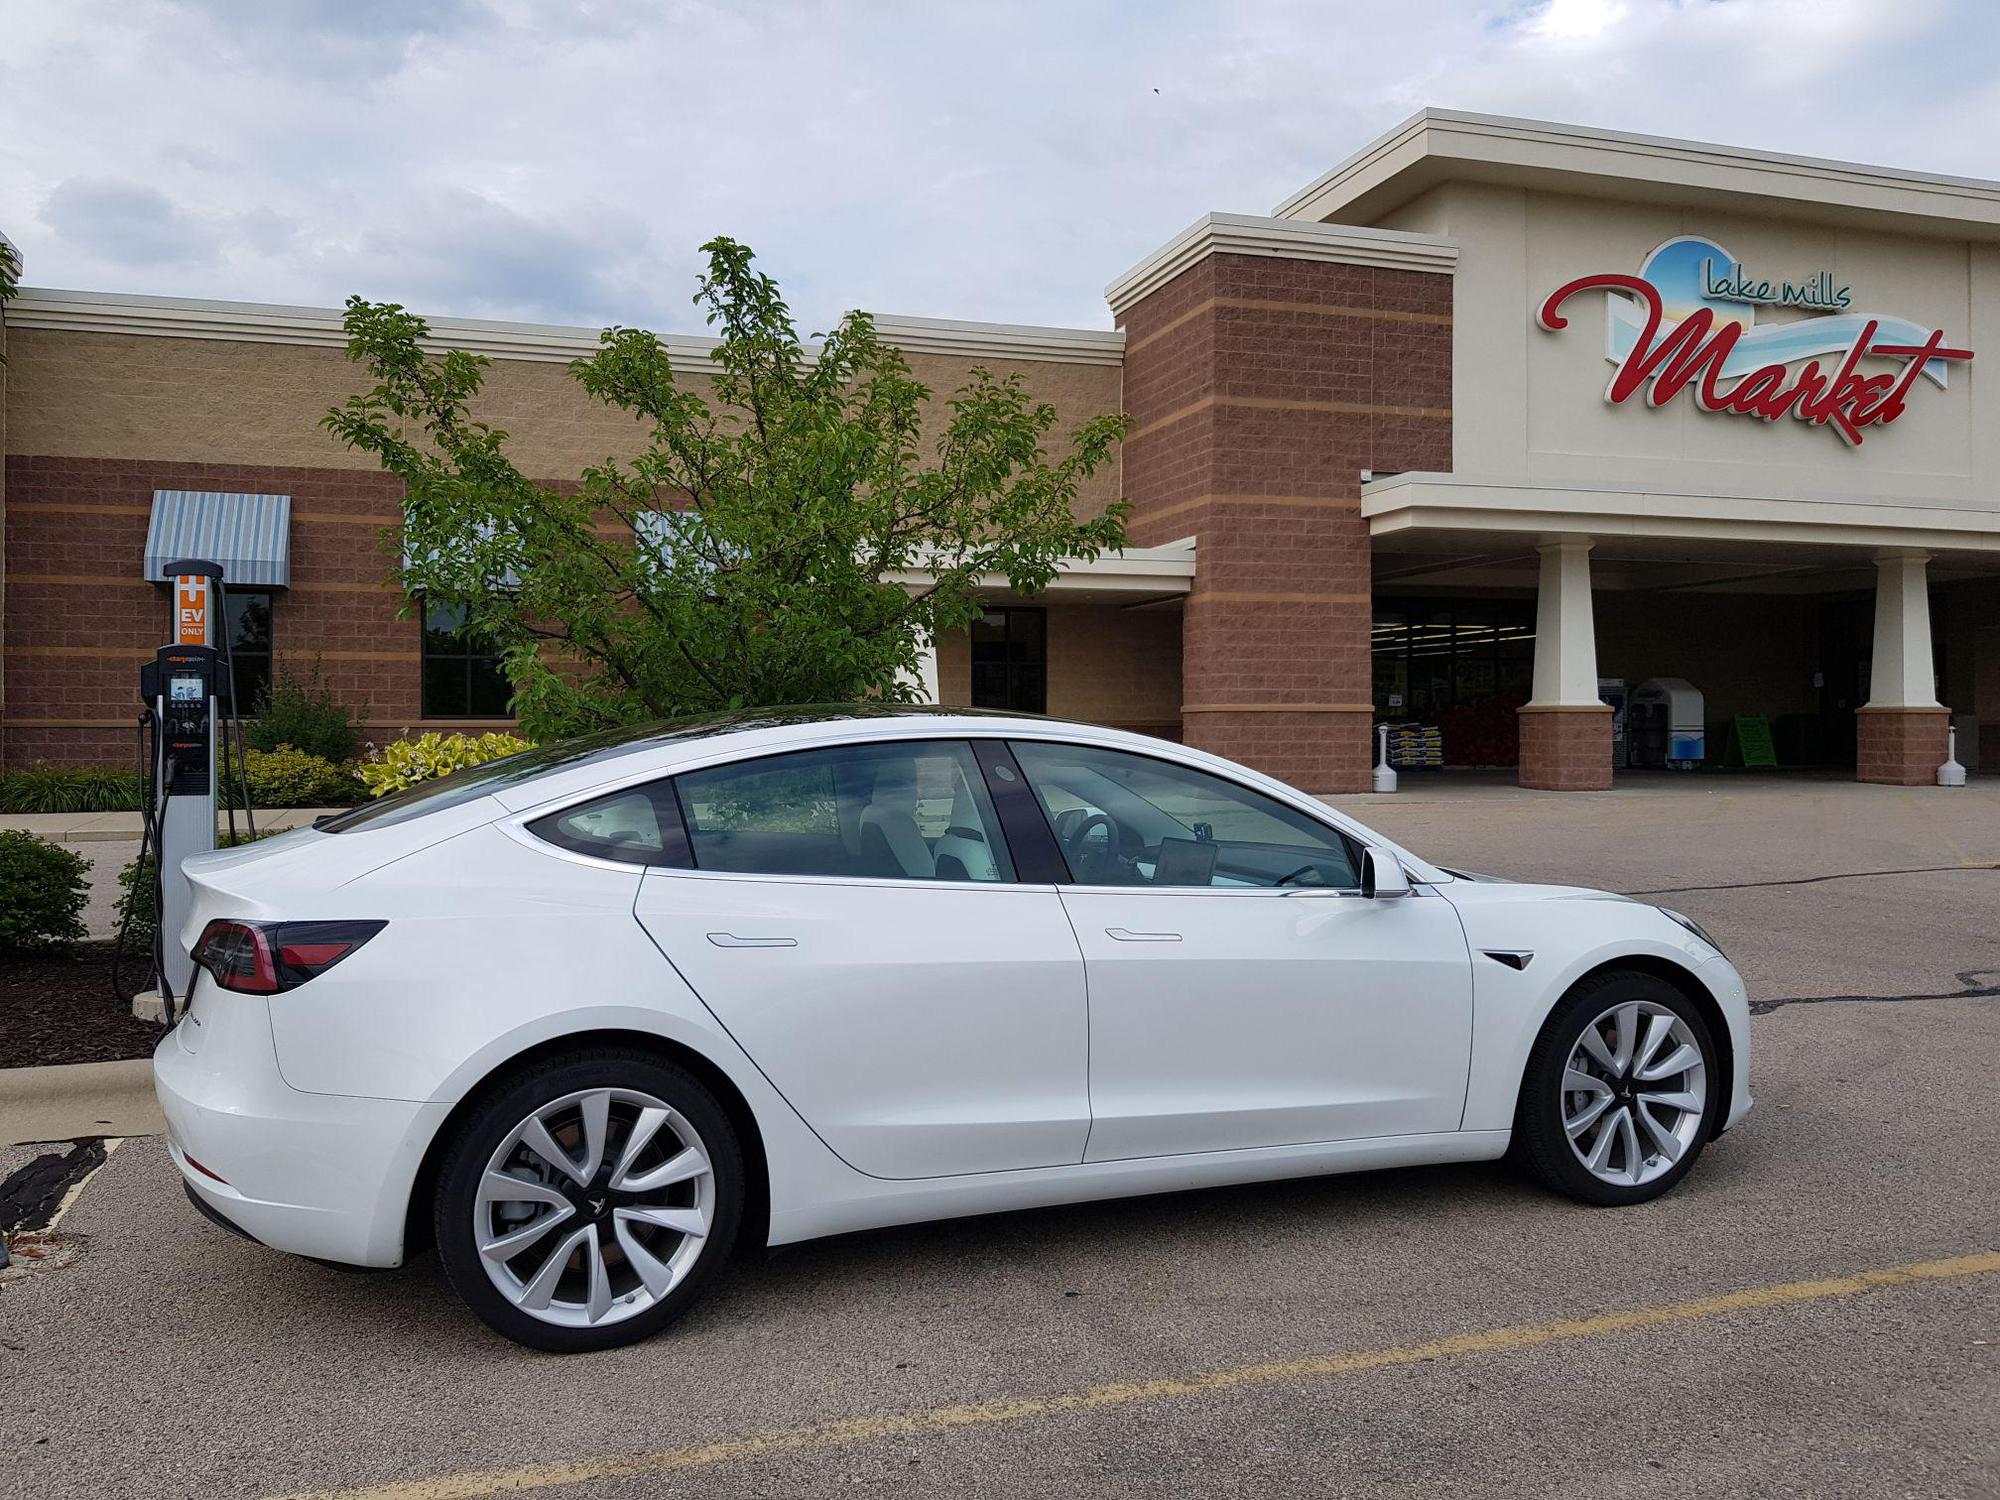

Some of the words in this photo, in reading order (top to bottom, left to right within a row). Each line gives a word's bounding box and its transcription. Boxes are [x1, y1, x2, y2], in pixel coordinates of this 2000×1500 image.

[1706, 258, 1777, 299] lake
[1782, 271, 1851, 308] mills
[1540, 273, 1975, 447] Market
[181, 608, 204, 622] EV
[181, 627, 204, 636] ONLY
